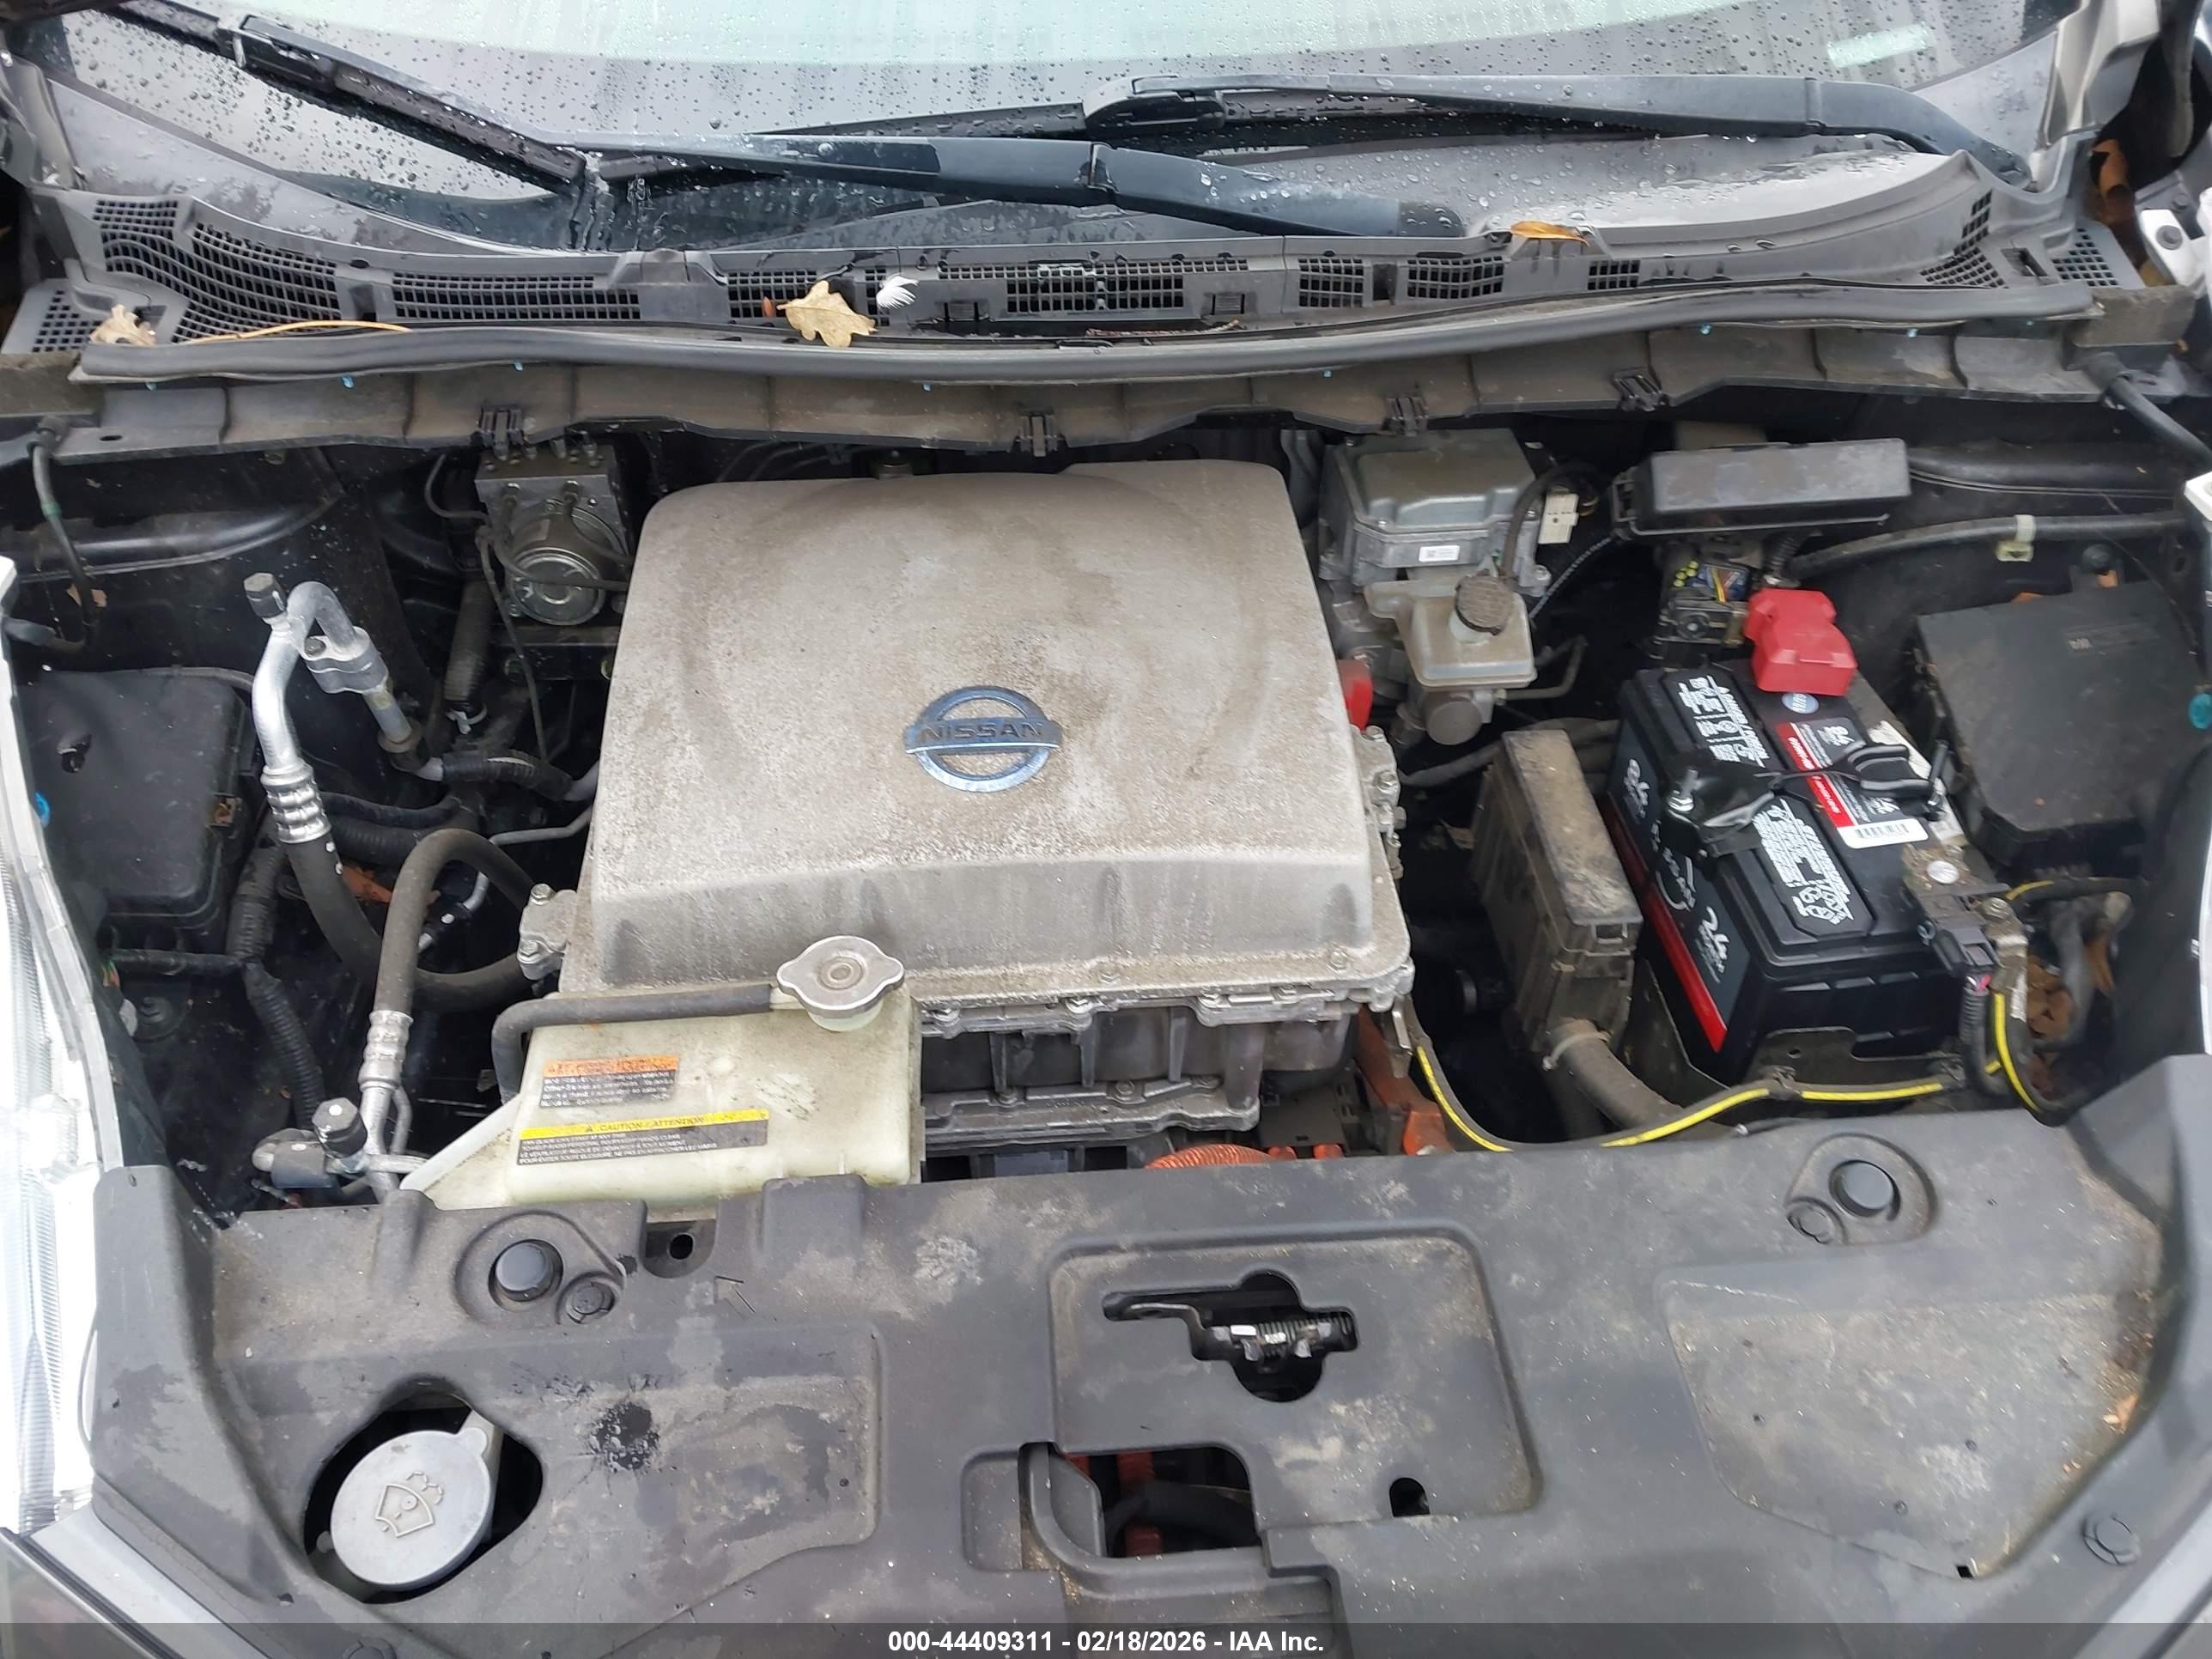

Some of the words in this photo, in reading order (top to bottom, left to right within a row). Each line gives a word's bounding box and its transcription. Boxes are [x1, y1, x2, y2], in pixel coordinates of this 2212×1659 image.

[921, 721, 1044, 741] NISSAN
[600, 1121, 641, 1132] CAUTION
[653, 1116, 706, 1128] ATTENTION
